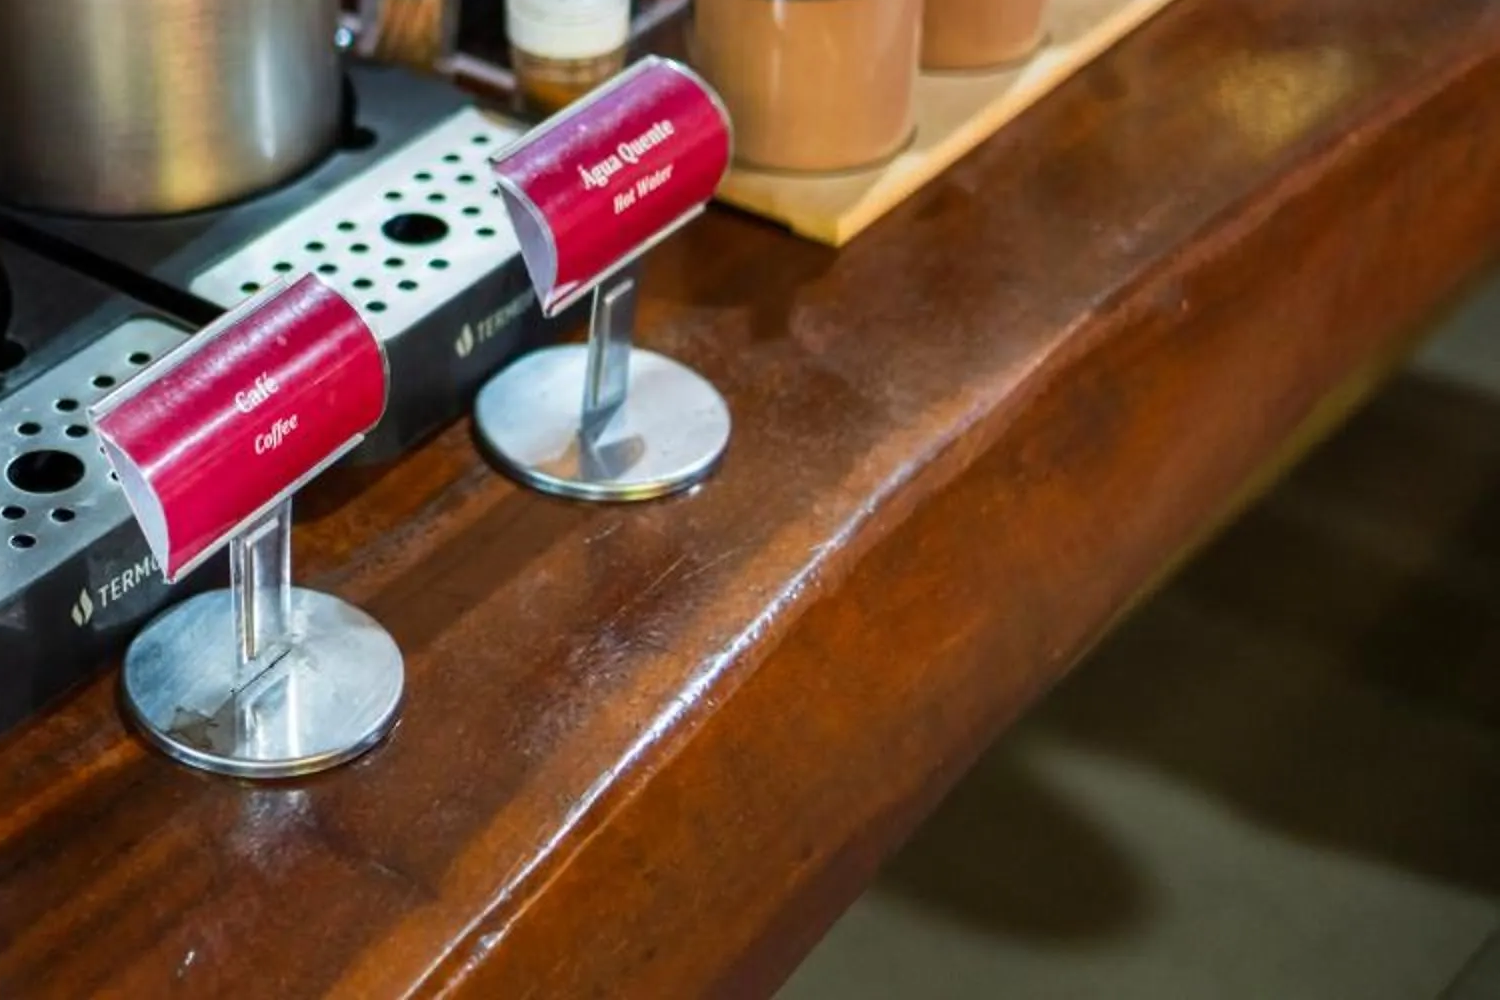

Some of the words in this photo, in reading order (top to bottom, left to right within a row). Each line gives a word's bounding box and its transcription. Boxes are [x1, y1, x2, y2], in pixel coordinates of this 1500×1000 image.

[617, 119, 674, 164] Quente
[613, 188, 636, 215] Hot
[636, 164, 673, 199] Water
[235, 371, 279, 413] Café
[255, 414, 298, 455] Coffee
